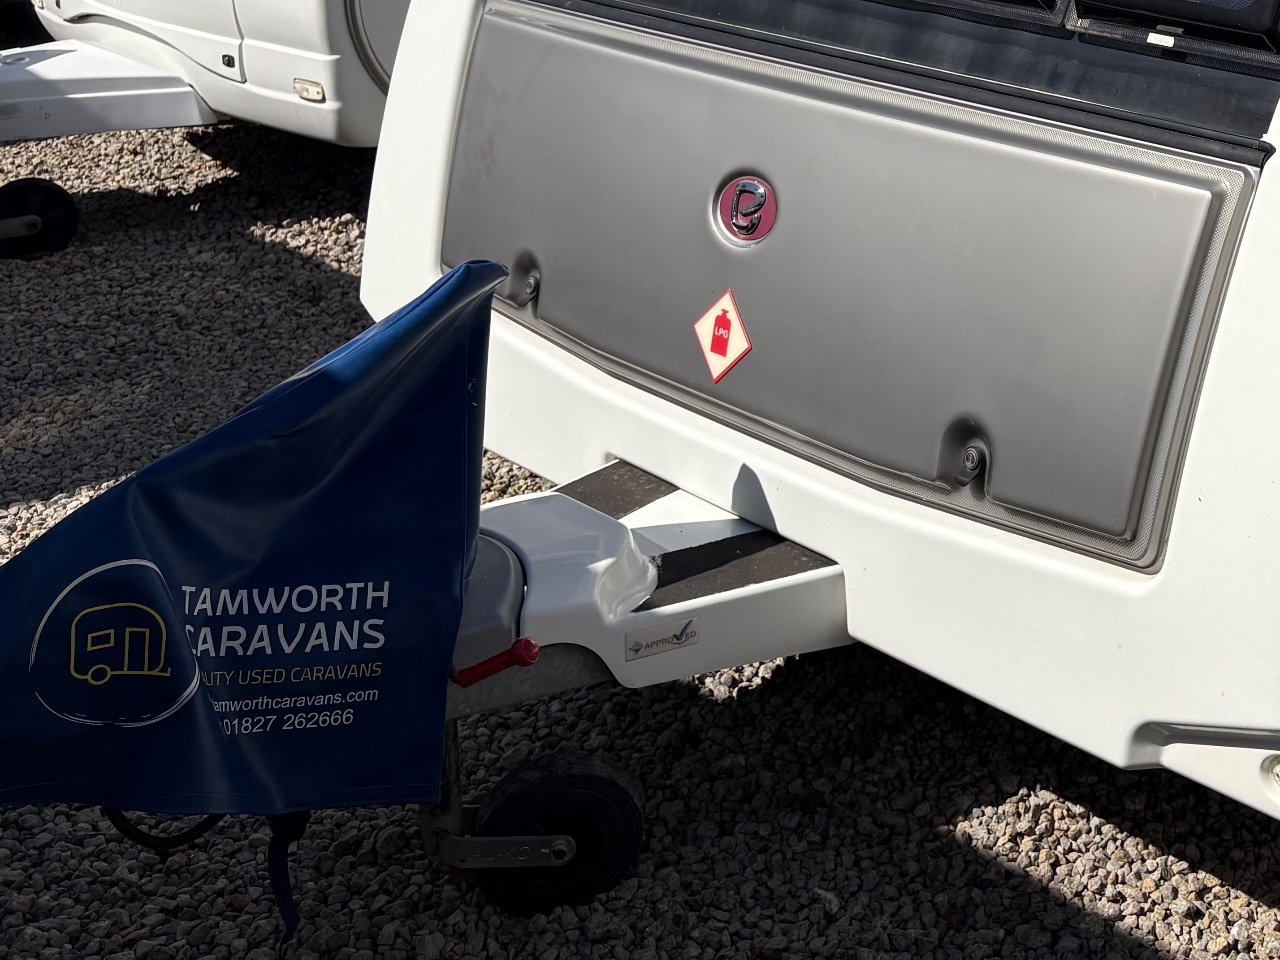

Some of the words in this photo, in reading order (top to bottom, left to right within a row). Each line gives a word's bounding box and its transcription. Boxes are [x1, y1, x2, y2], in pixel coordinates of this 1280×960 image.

[714, 326, 729, 340] LPG
[182, 581, 390, 616] TAMWORTH
[238, 668, 286, 686] USED
[290, 662, 383, 682] CARAVANS
[283, 709, 353, 730] 262666
